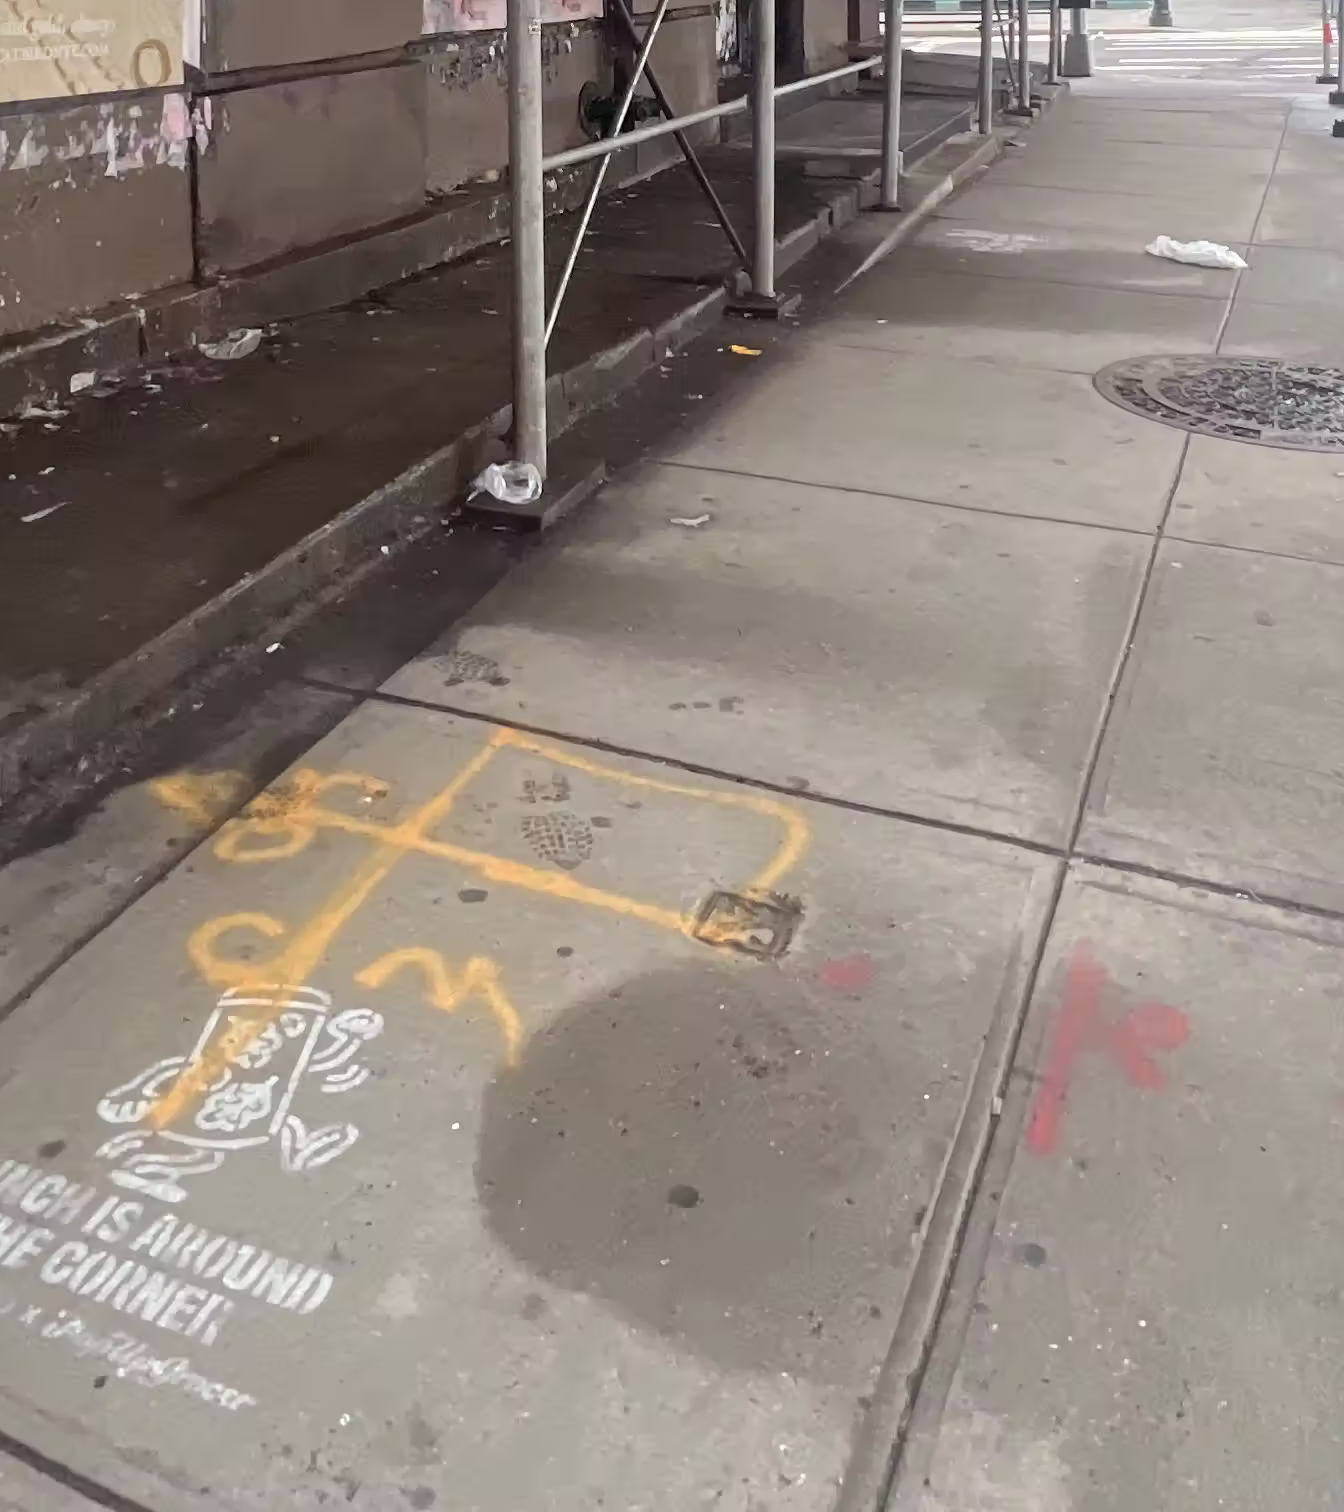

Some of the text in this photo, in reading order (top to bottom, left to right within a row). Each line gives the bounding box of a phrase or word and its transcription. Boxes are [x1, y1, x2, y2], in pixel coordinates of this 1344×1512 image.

[39, 1240, 237, 1346] CORNER
[80, 1194, 144, 1243] IS
[128, 1212, 334, 1315] AROUND
